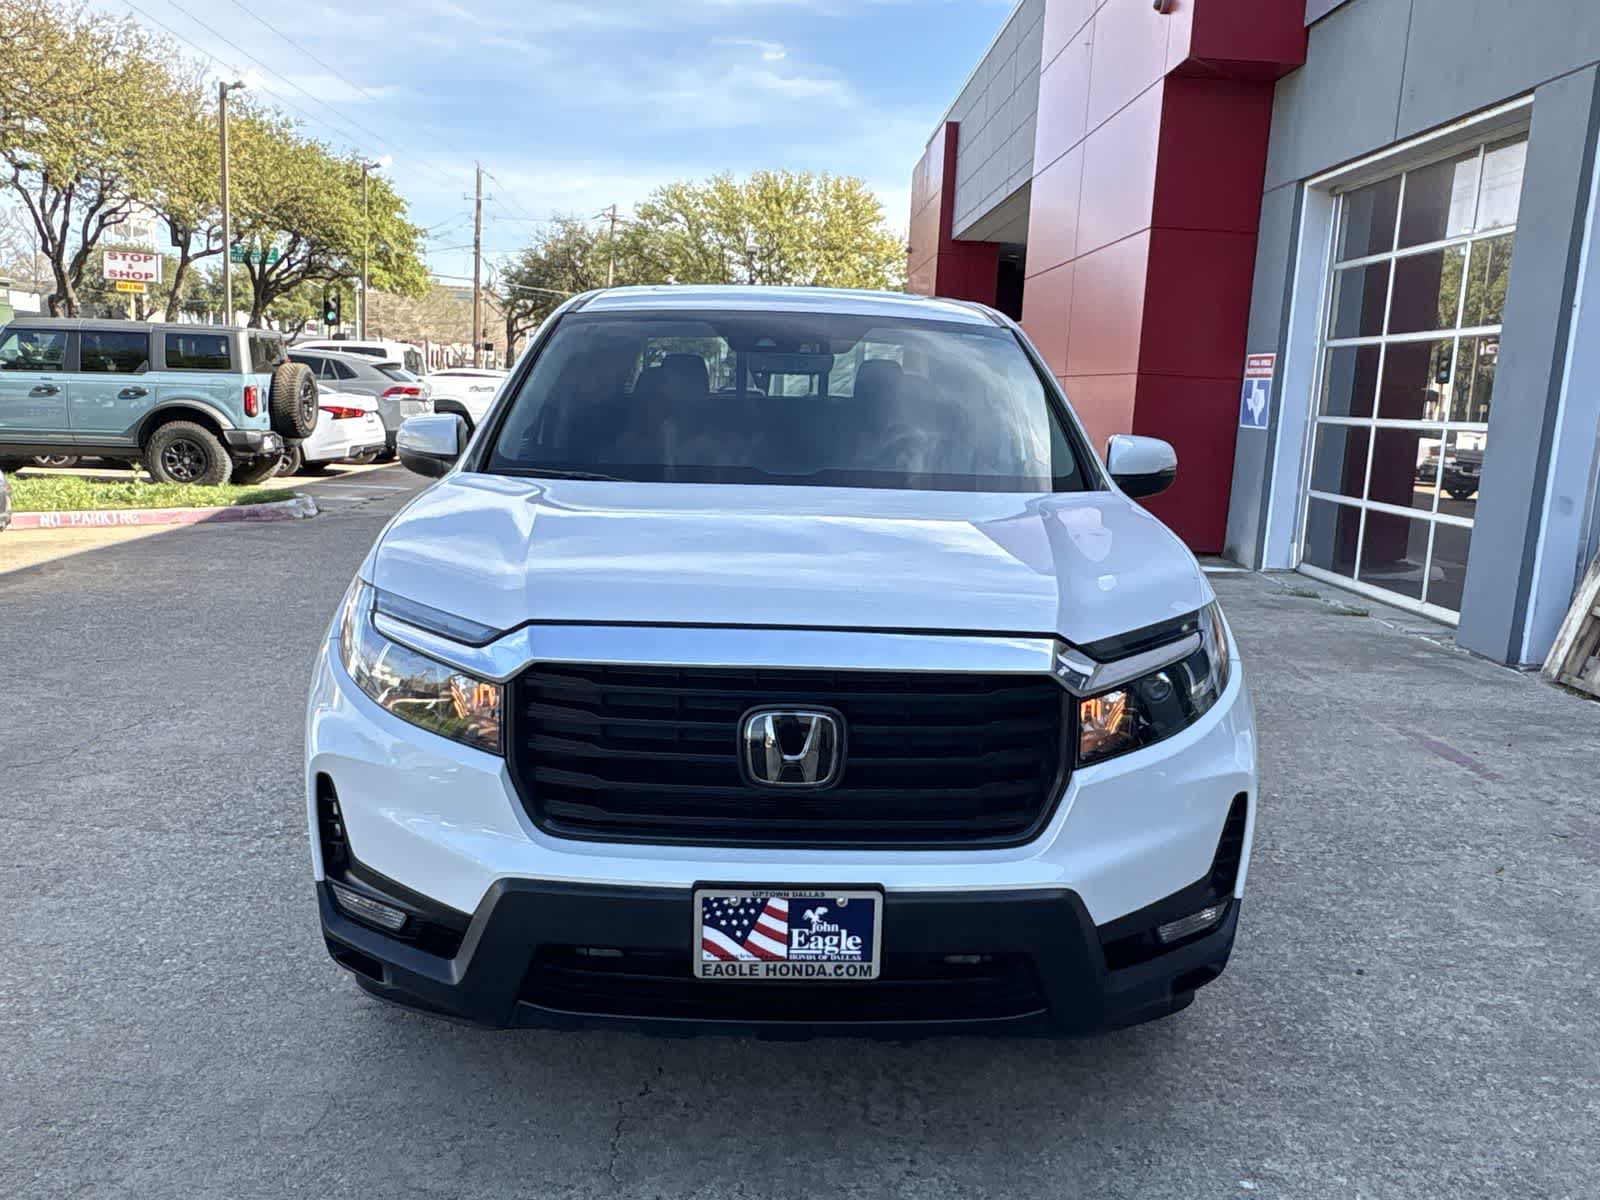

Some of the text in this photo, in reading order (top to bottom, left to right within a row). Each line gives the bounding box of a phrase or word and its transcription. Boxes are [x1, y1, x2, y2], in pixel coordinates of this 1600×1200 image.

[107, 252, 153, 262] STOP
[107, 269, 154, 280] SHOP
[40, 512, 61, 528] NO
[752, 890, 825, 898] UPTOWN DALLAS
[810, 921, 839, 934] John
[789, 928, 862, 955] Eagle
[702, 963, 873, 977] EAGLE HONDA.COM
